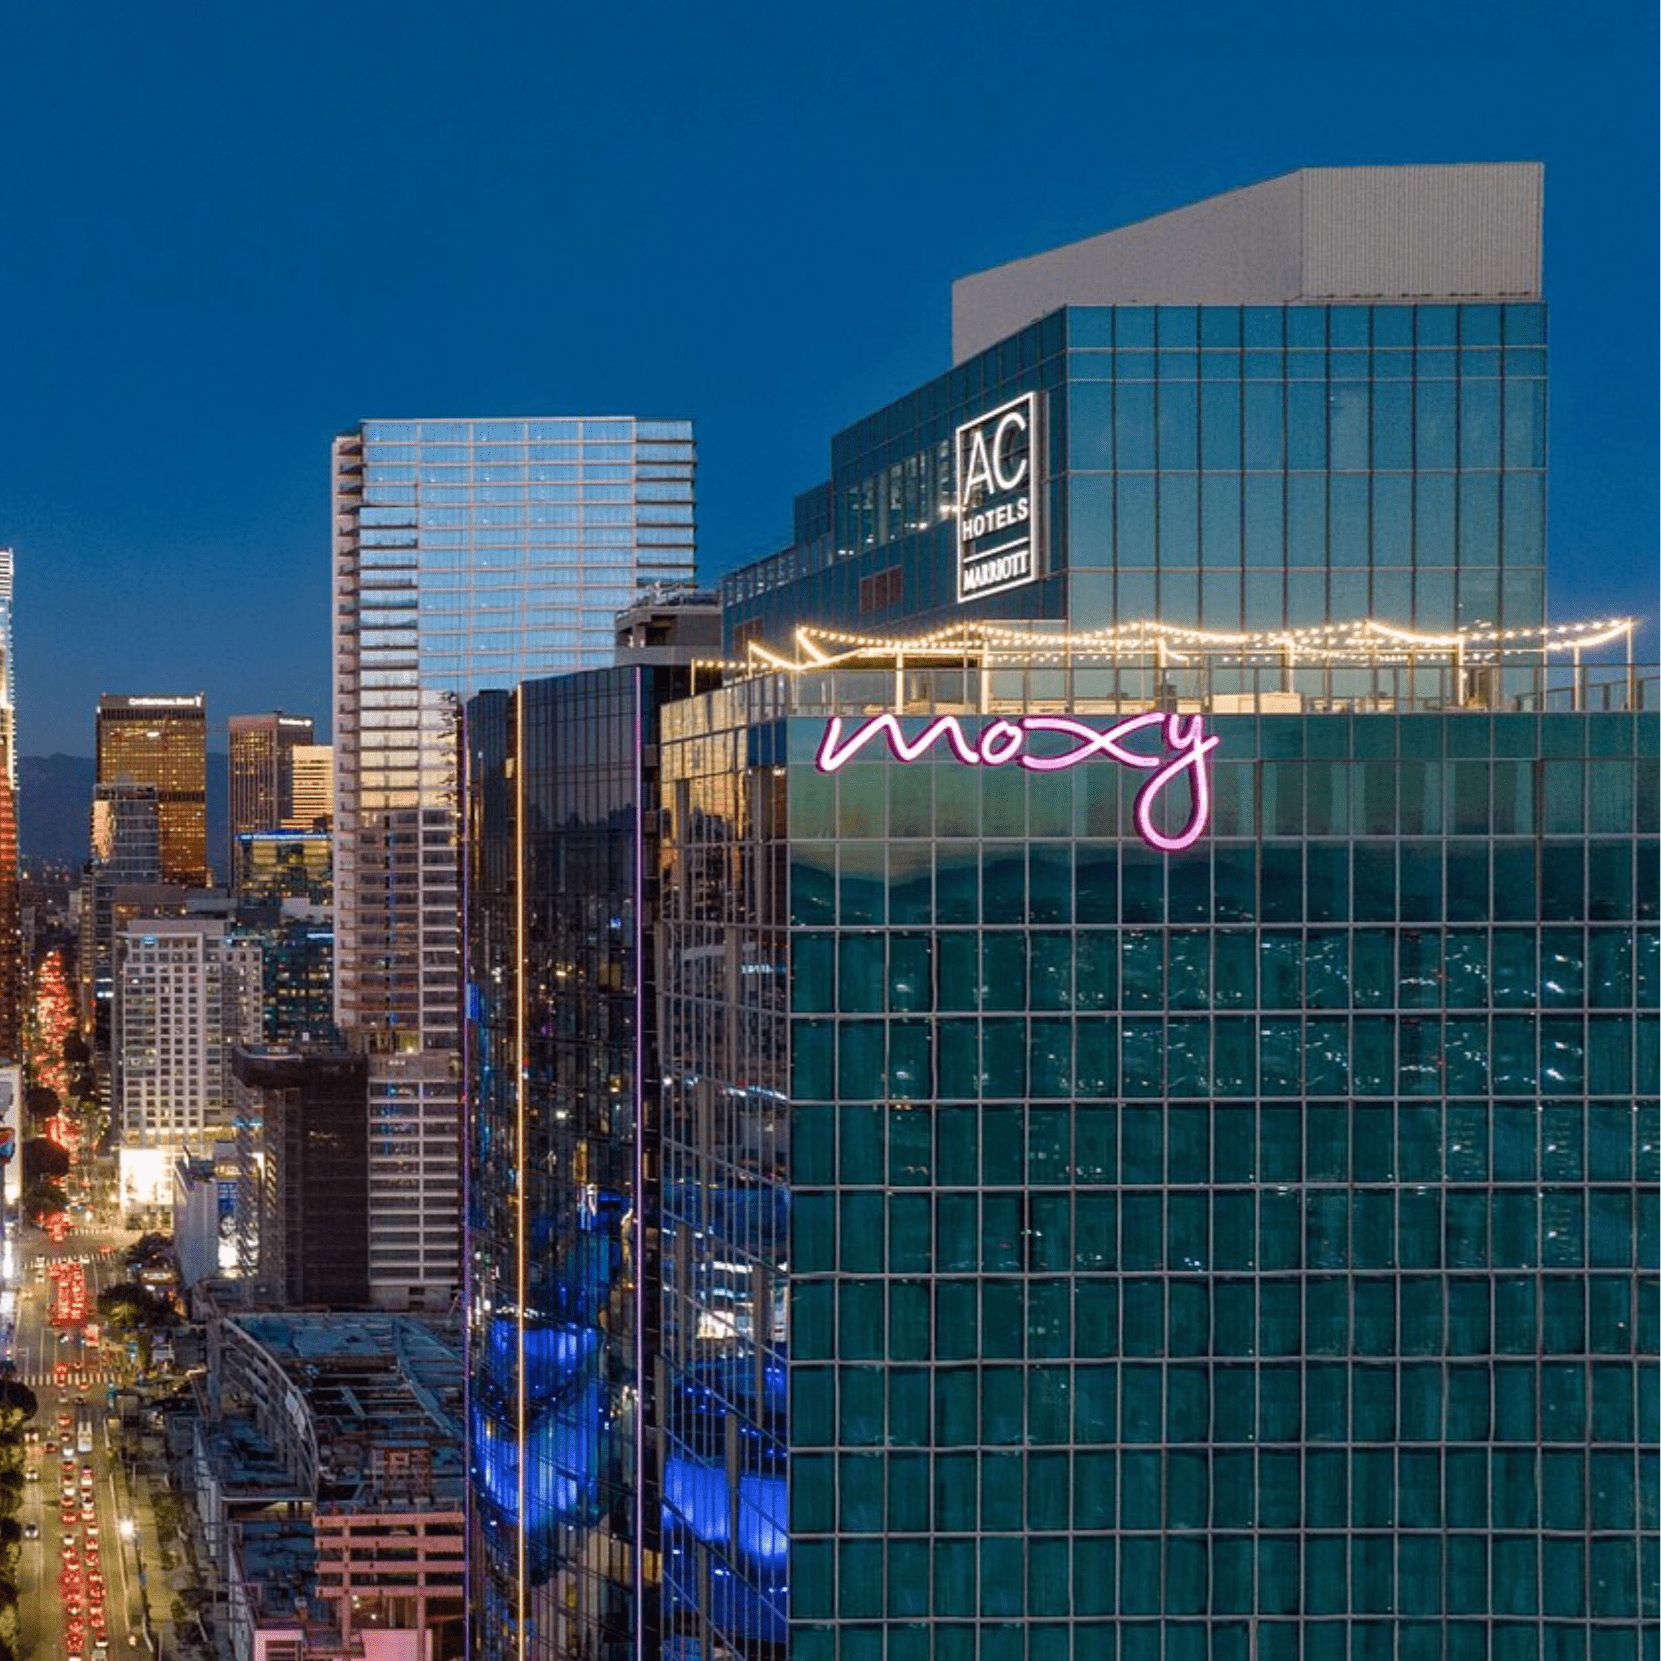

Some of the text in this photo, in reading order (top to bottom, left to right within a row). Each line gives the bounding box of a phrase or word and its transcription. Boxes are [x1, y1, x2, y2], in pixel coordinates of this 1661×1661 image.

[963, 412, 1027, 506] AC
[962, 497, 1029, 542] HOTELS
[963, 550, 1029, 592] MARRIOTT
[816, 713, 1220, 853] moxy
